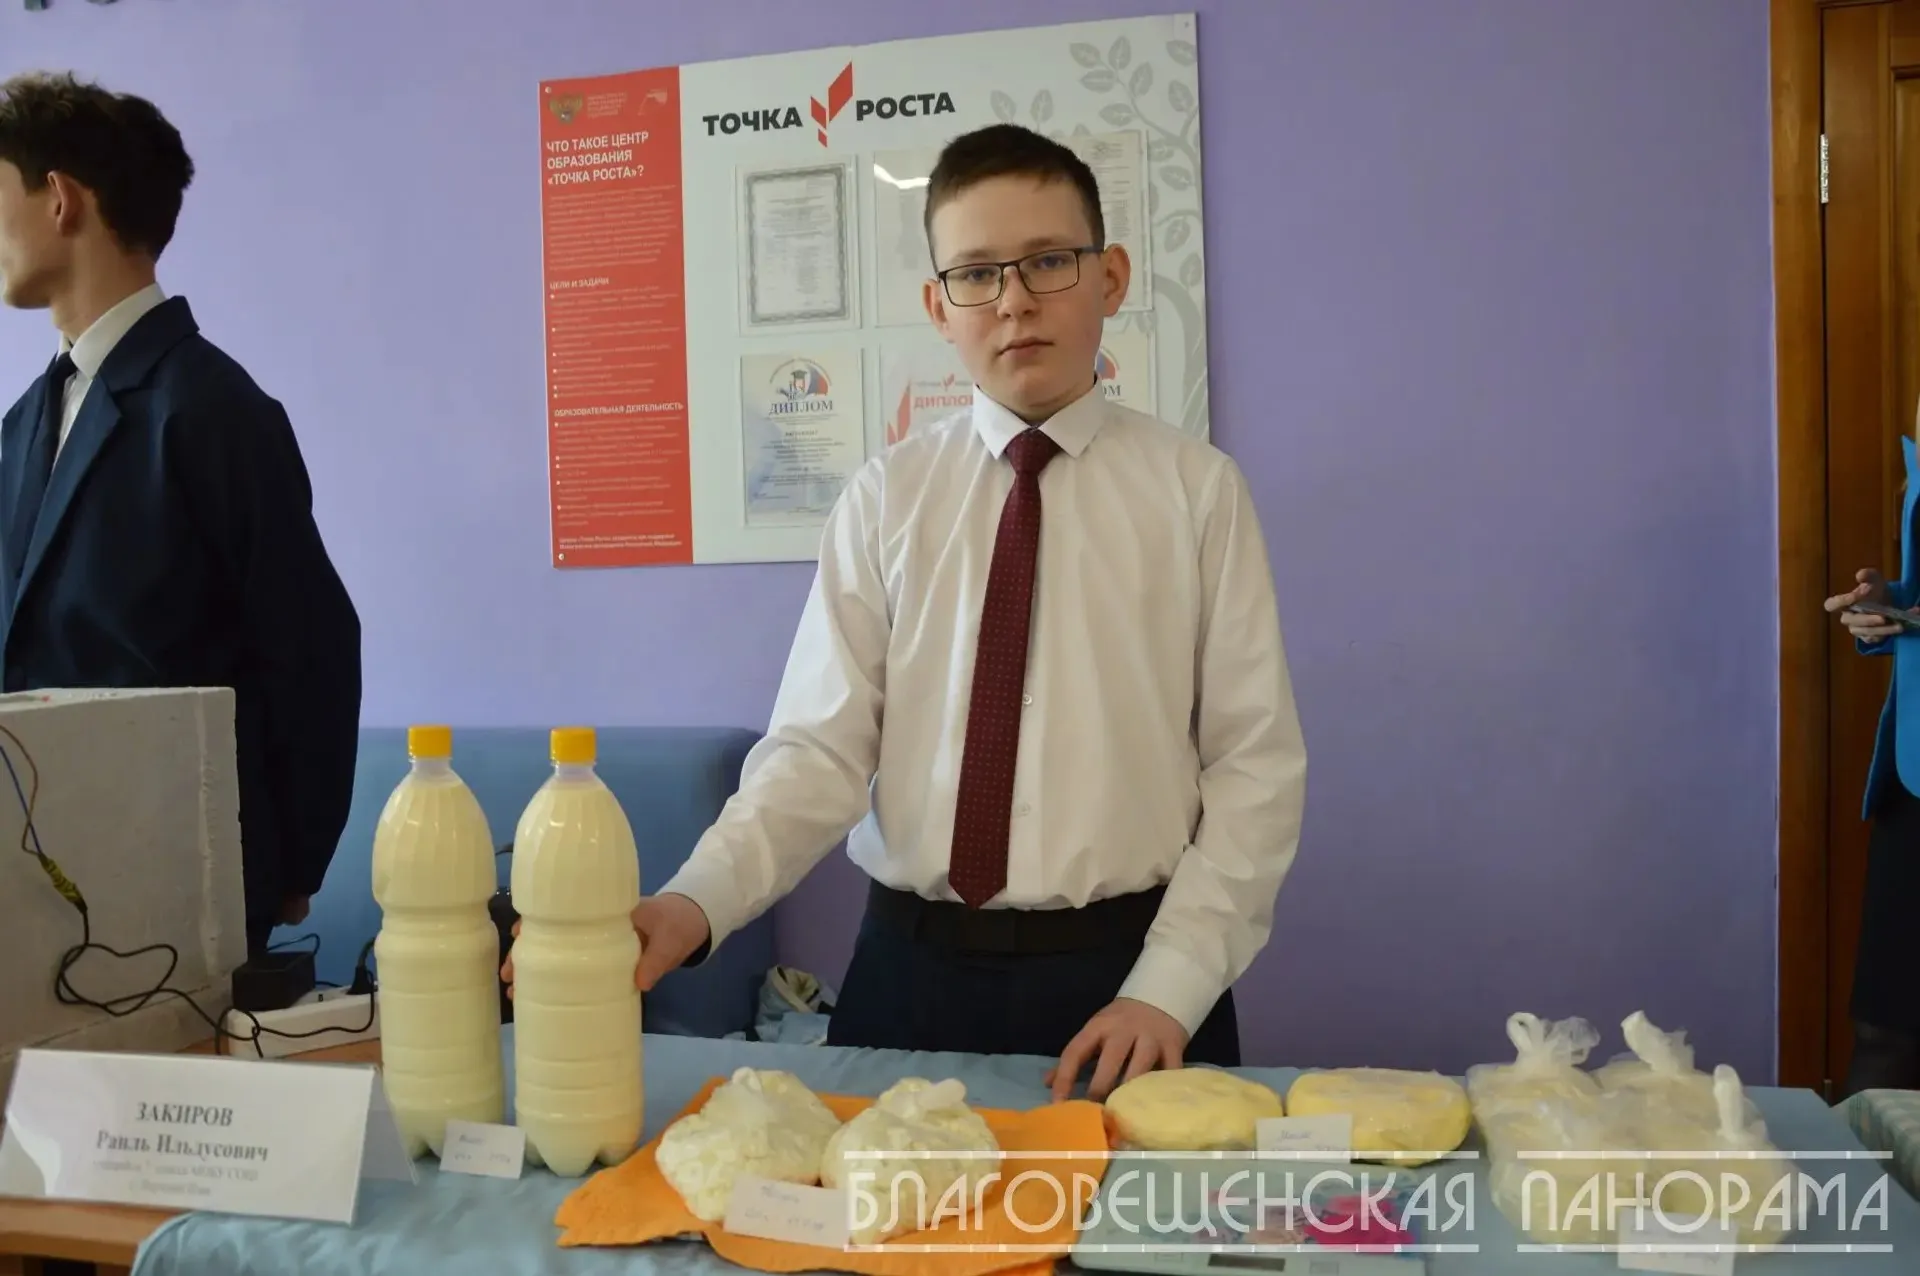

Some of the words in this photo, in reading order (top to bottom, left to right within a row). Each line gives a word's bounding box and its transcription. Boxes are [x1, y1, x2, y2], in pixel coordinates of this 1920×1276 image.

[702, 106, 804, 136] ТОЧКА
[856, 92, 956, 121] РОСТА
[546, 140, 569, 153] ЧТО
[572, 135, 608, 151] ТАКОЕ
[611, 131, 649, 148] ЦЕНТР
[547, 149, 633, 170] ОБРАЗОВАНИЯ
[547, 171, 590, 186] «ТОЧКА
[593, 164, 645, 182] РОСТА»?
[550, 280, 570, 290] ЦЕЛИ
[579, 277, 609, 288] ЗАДАЧИ
[554, 404, 624, 417] ОБРАЗОВАТЕЛЬНАЯ
[625, 401, 683, 415] ДЕЯТЕЛЬНОСТЬ
[769, 400, 833, 415] ДИПЛОМ
[136, 1101, 233, 1127] ЗАКИРОВ
[96, 1129, 151, 1154] Раиль
[156, 1133, 269, 1162] Ильдусович
